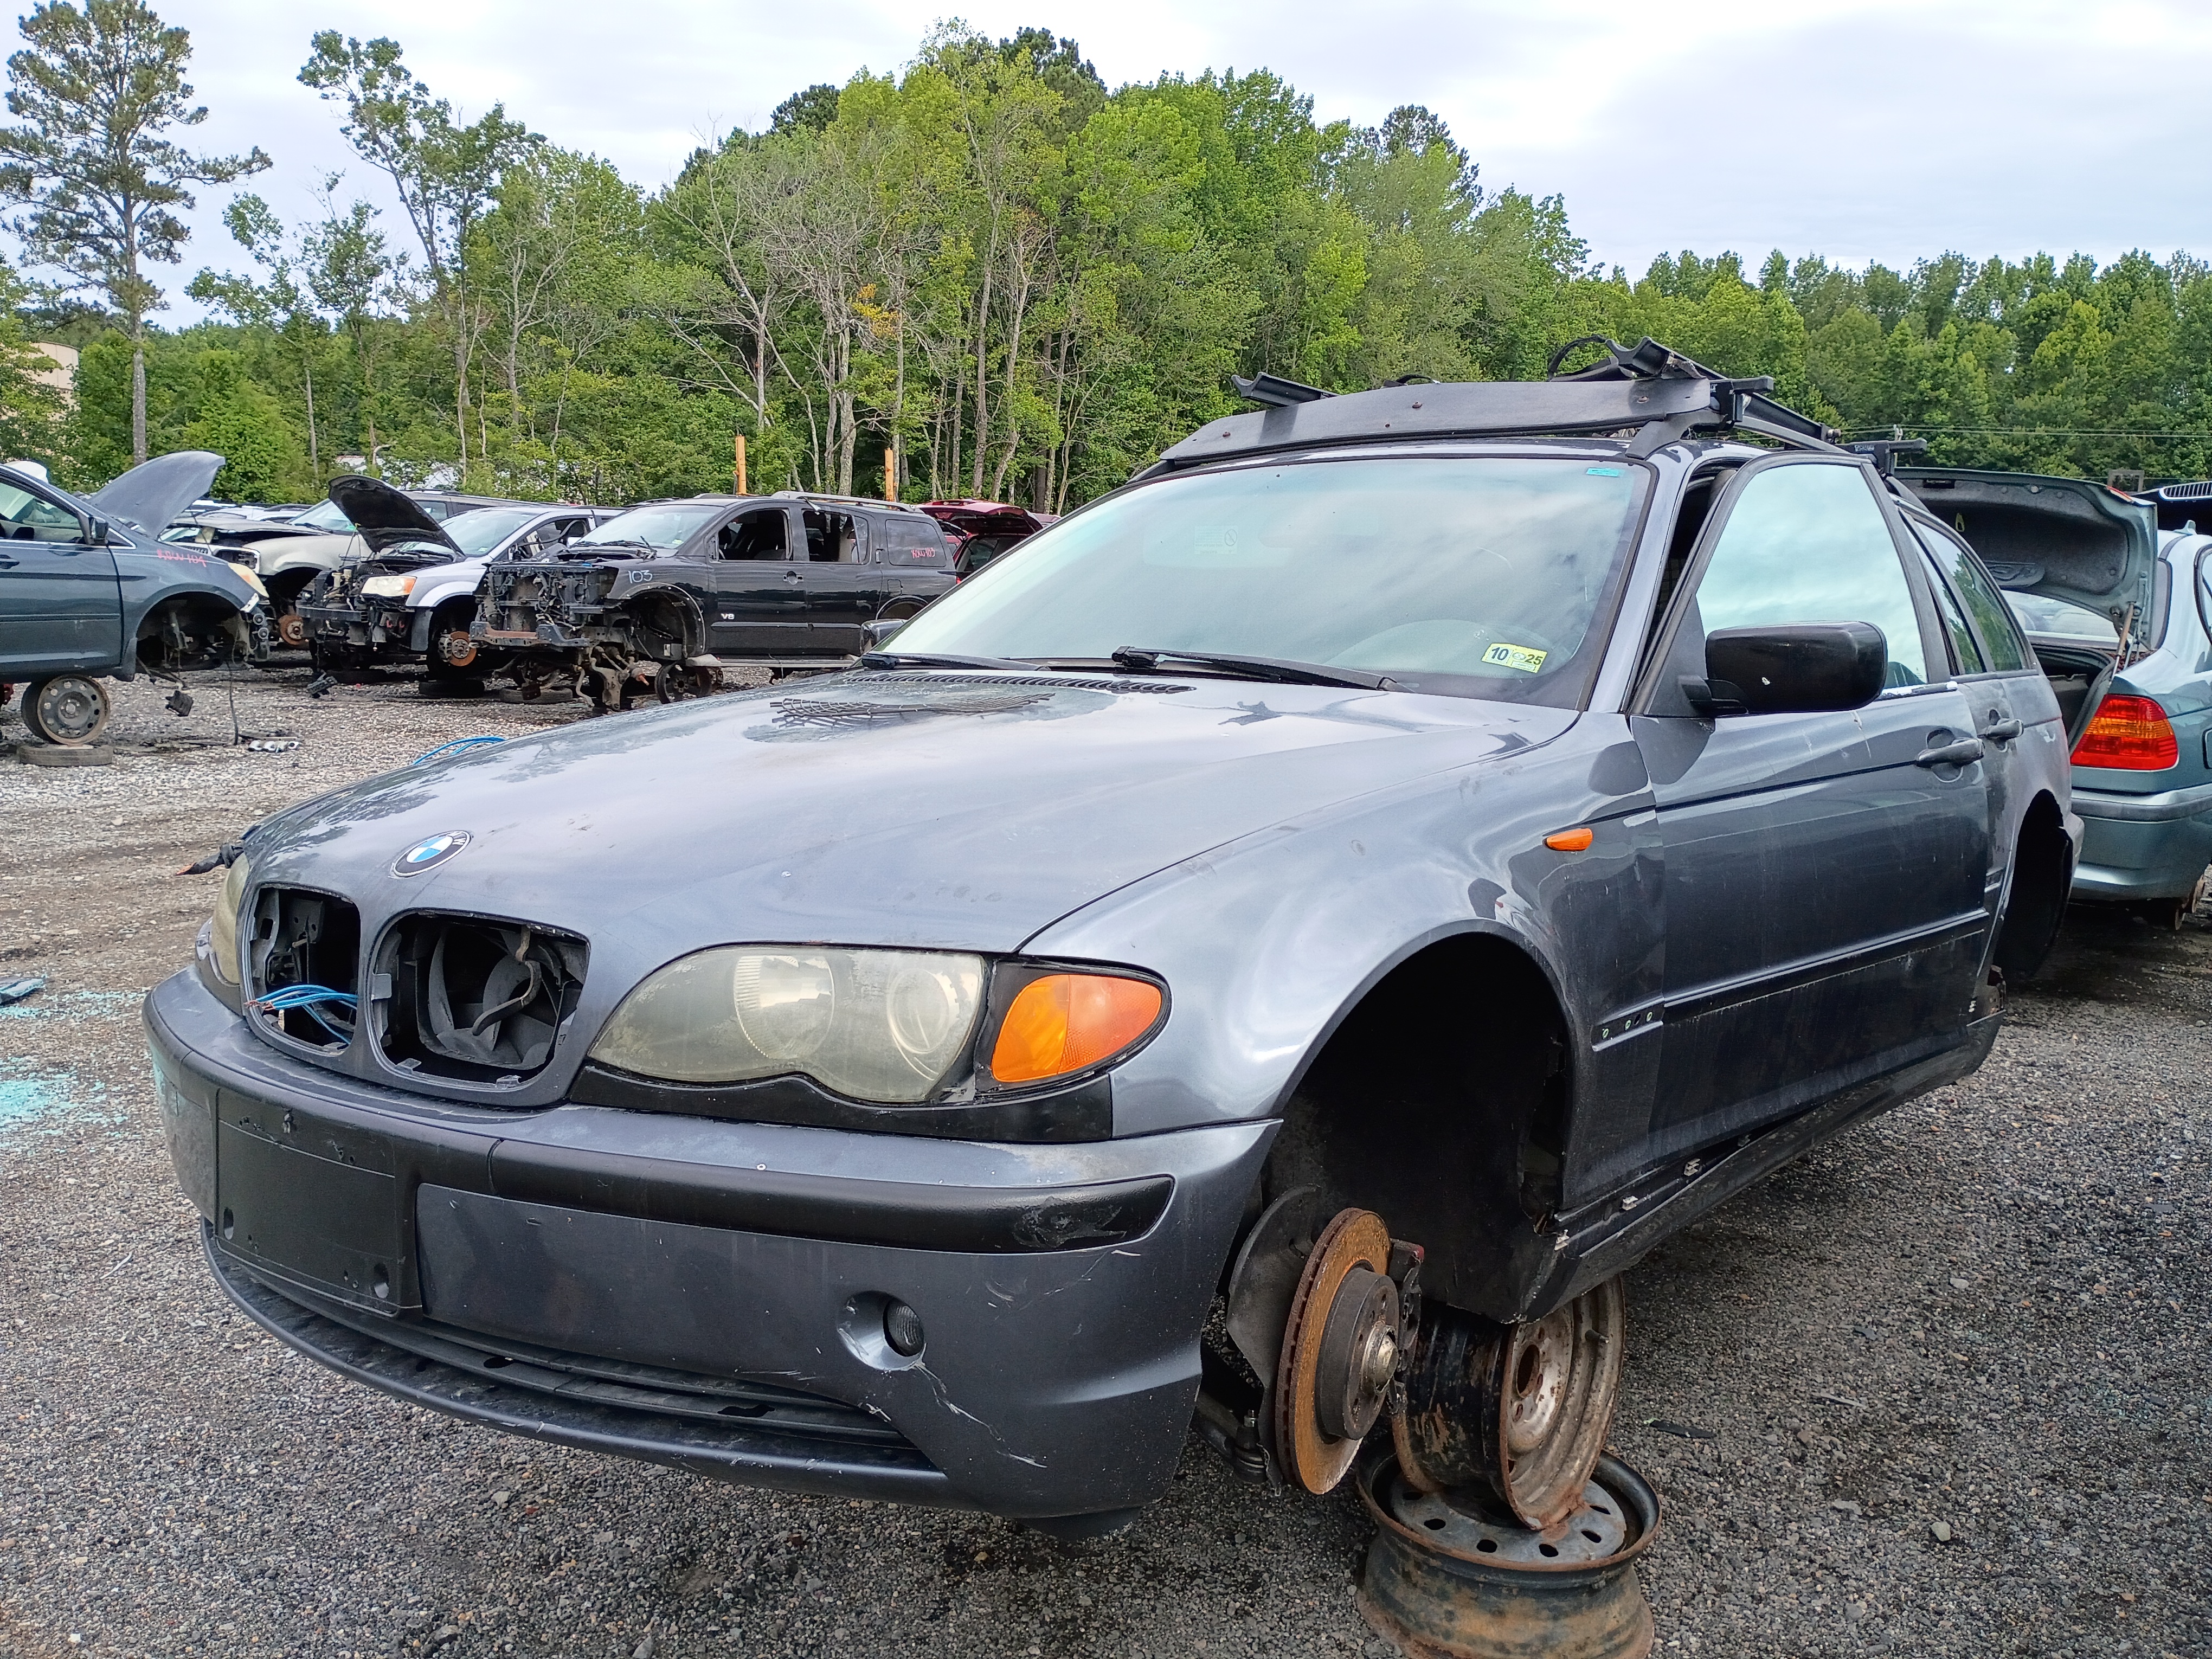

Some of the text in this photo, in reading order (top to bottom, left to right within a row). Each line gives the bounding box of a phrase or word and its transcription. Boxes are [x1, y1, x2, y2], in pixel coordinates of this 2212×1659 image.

[628, 569, 653, 584] 103
[1491, 647, 1509, 661] 10
[1524, 654, 1544, 665] 25
